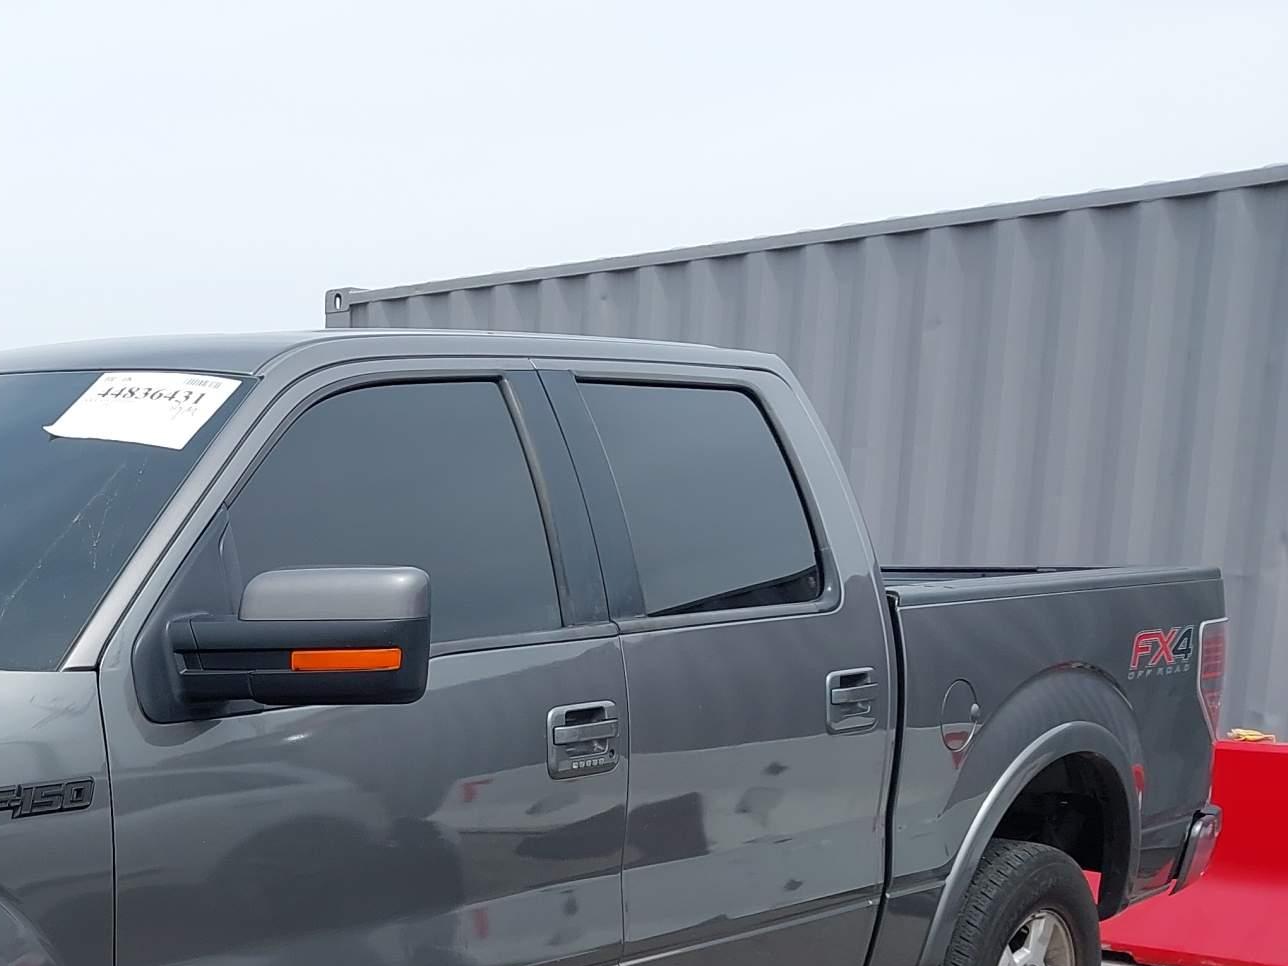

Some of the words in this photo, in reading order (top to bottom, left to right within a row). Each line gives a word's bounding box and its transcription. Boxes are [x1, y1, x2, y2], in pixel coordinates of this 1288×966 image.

[98, 386, 206, 405] 44836431
[1129, 625, 1194, 671] FX4
[1127, 669, 1154, 681] OFF
[1156, 664, 1191, 676] ROAD
